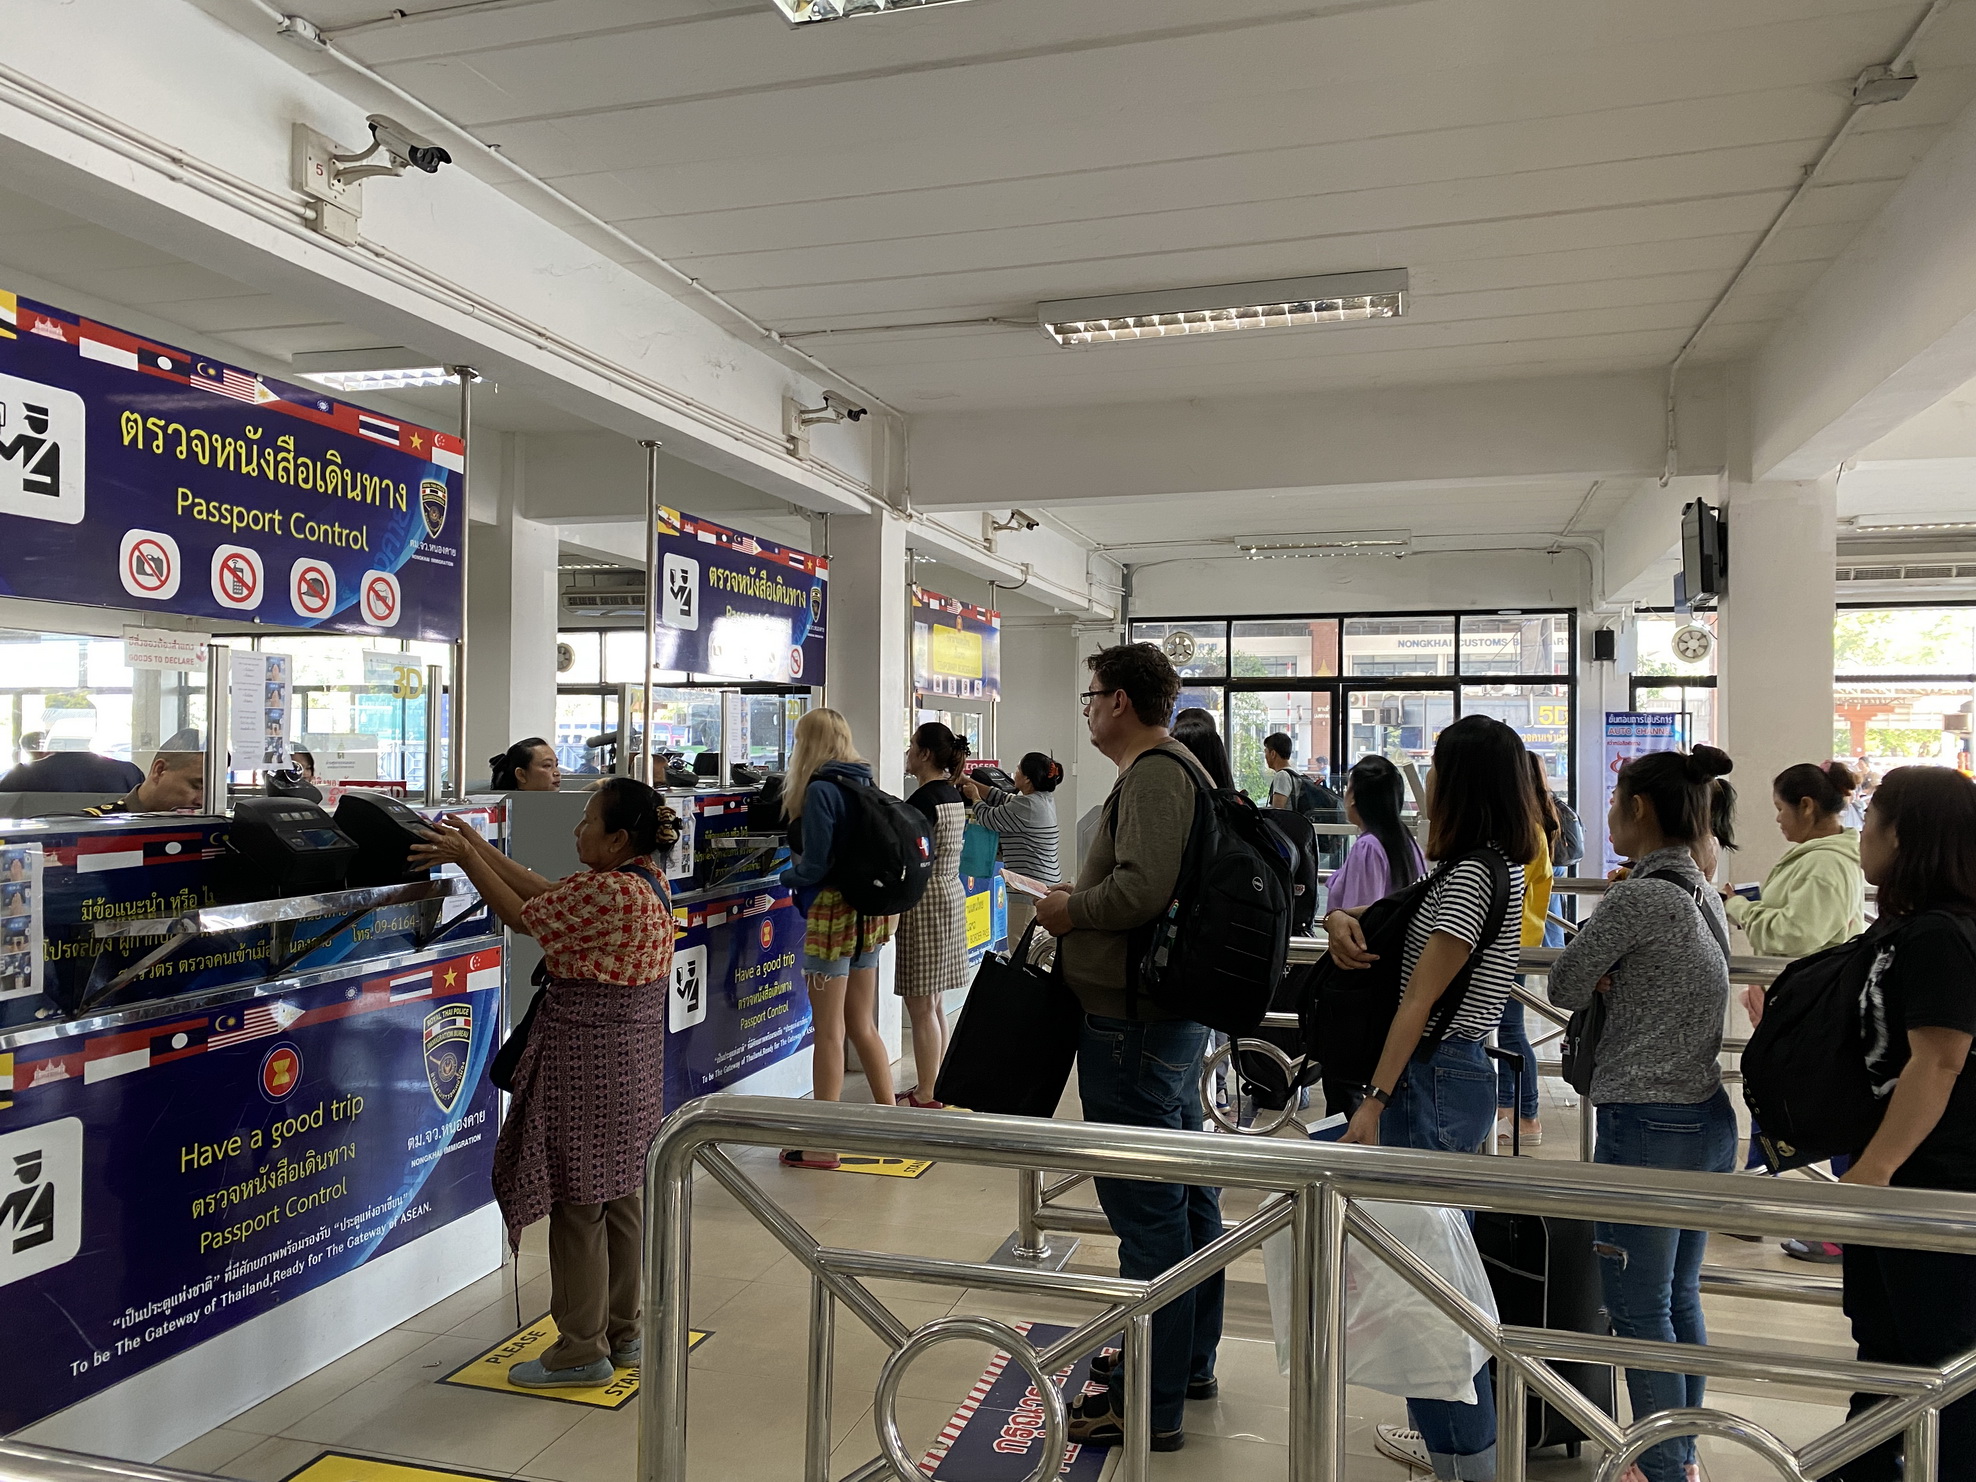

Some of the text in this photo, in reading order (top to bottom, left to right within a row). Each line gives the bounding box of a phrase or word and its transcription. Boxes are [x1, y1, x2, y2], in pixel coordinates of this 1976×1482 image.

[316, 163, 324, 176] 5
[120, 409, 407, 512] ตรวจหนังสือเดินทาง
[177, 488, 370, 552] Passport Control
[709, 566, 807, 608] ตรวจหนังสือเดินทาง
[1398, 639, 1453, 648] NONGKHAI
[1458, 638, 1508, 647] CUSTOMS
[129, 653, 153, 663] GOODS
[165, 656, 195, 666] DECLARE
[392, 666, 423, 699] 3D
[1608, 727, 1674, 736] AUTO CHANNEL
[81, 894, 165, 922] มีข้อแนะนำ
[735, 952, 795, 983] Have a good trip
[738, 980, 792, 1010] ตรวจหนังสือเดินทาง
[427, 1007, 470, 1027] ROYAL THAI POLICE
[740, 1000, 789, 1030] Passport Control
[702, 1075, 708, 1084] To
[708, 1073, 714, 1081] be
[715, 1069, 723, 1078] The
[723, 1060, 740, 1073] Gateway
[181, 1094, 364, 1173] Have a good trip
[407, 1110, 486, 1151] ตม.จว.หนองคาย
[411, 1133, 482, 1168] NONGKHAI IMMIGRATION
[192, 1142, 356, 1220] ตรวจหนังสือเดินทาง
[200, 1176, 348, 1254] Passport Control
[70, 1360, 88, 1377] To
[94, 1351, 110, 1367] be
[115, 1336, 141, 1356] The
[145, 1308, 200, 1342] Gateway
[204, 1298, 217, 1315] of
[308, 1252, 323, 1267] for
[326, 1243, 344, 1259] The
[347, 1222, 387, 1249] Gateway
[389, 1216, 398, 1229] of
[400, 1201, 432, 1224] ASEAN.
[484, 1330, 546, 1365] PLEASE
[604, 1369, 640, 1396] STAN
